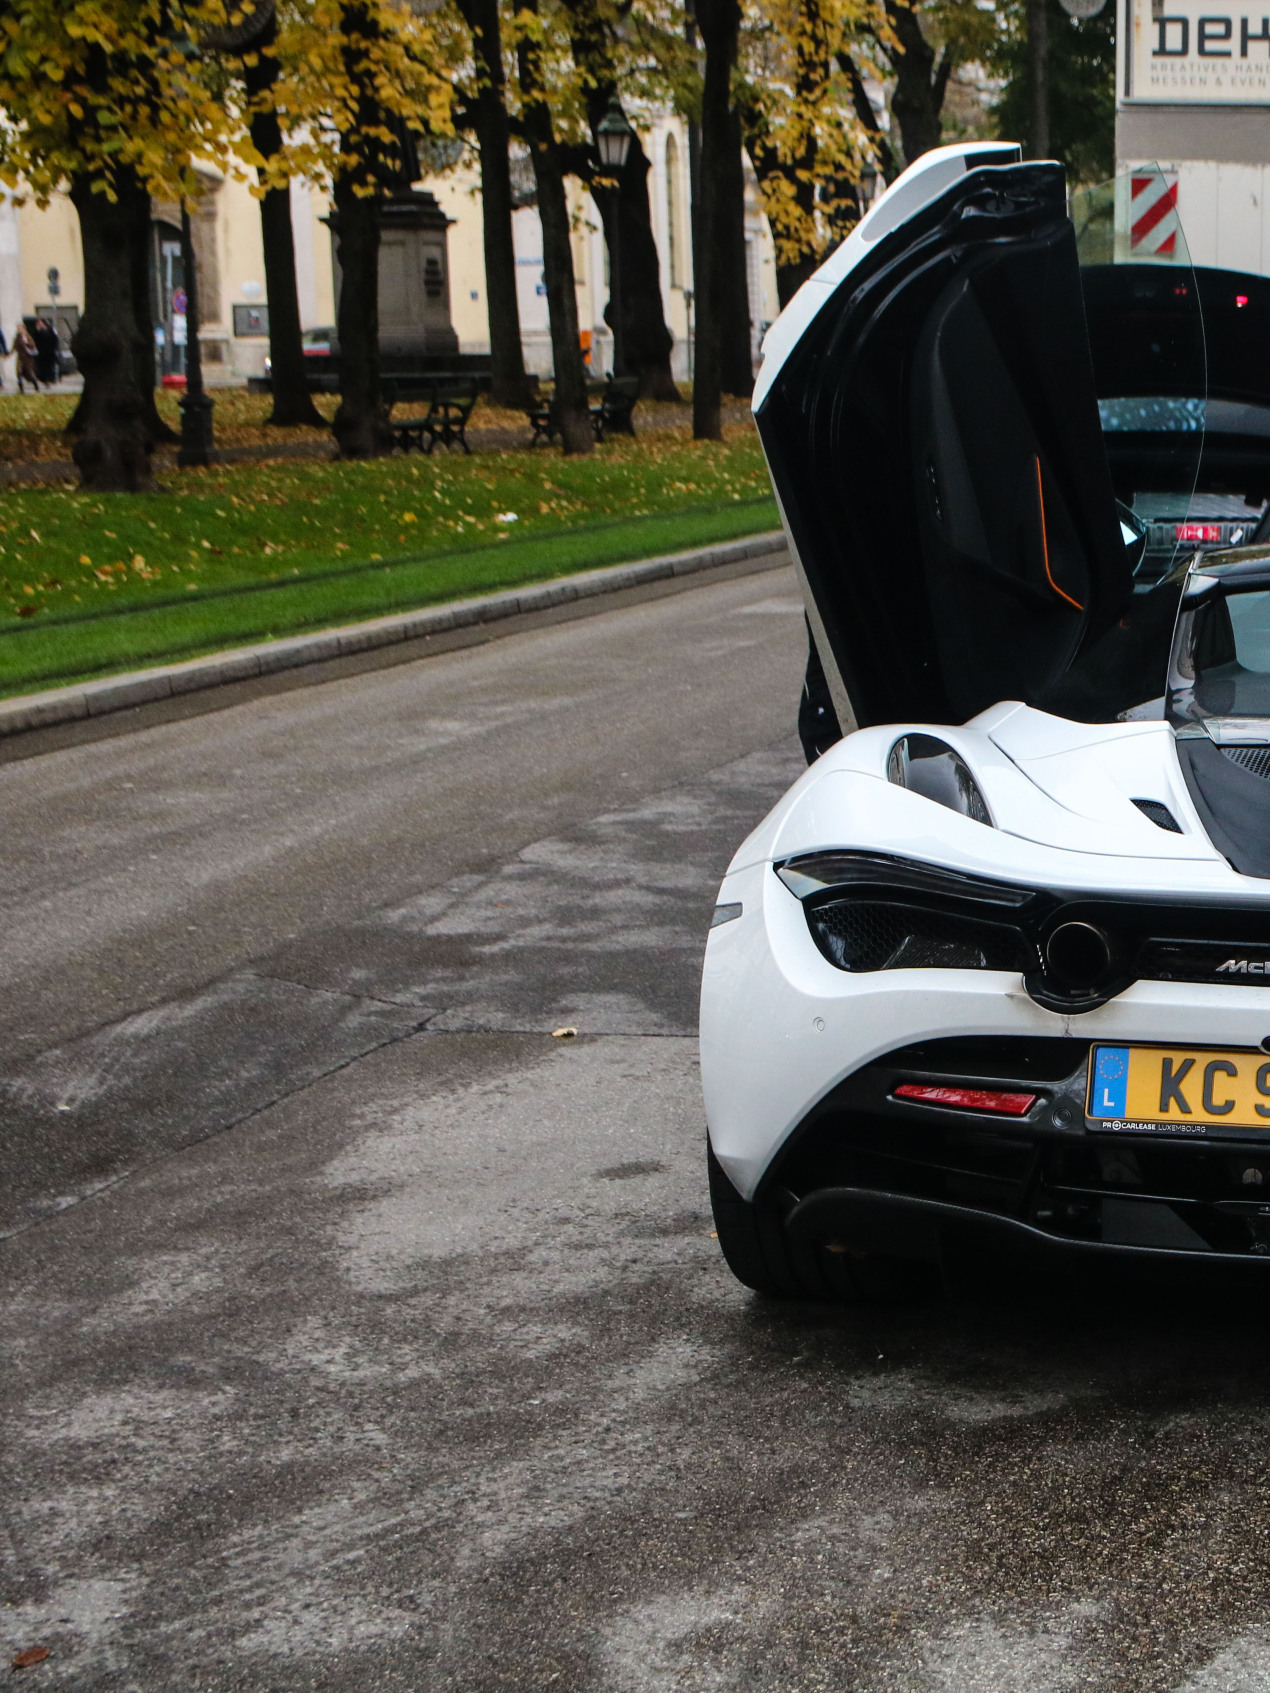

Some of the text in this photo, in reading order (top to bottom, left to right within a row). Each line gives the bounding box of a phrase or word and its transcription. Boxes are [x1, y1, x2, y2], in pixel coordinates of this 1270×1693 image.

[1151, 62, 1229, 73] KREATIVES
[1151, 76, 1208, 87] MESSEN
[1159, 1057, 1238, 1115] KC
[1103, 1088, 1115, 1107] L
[1158, 1123, 1206, 1134] LUXEMBOURG
